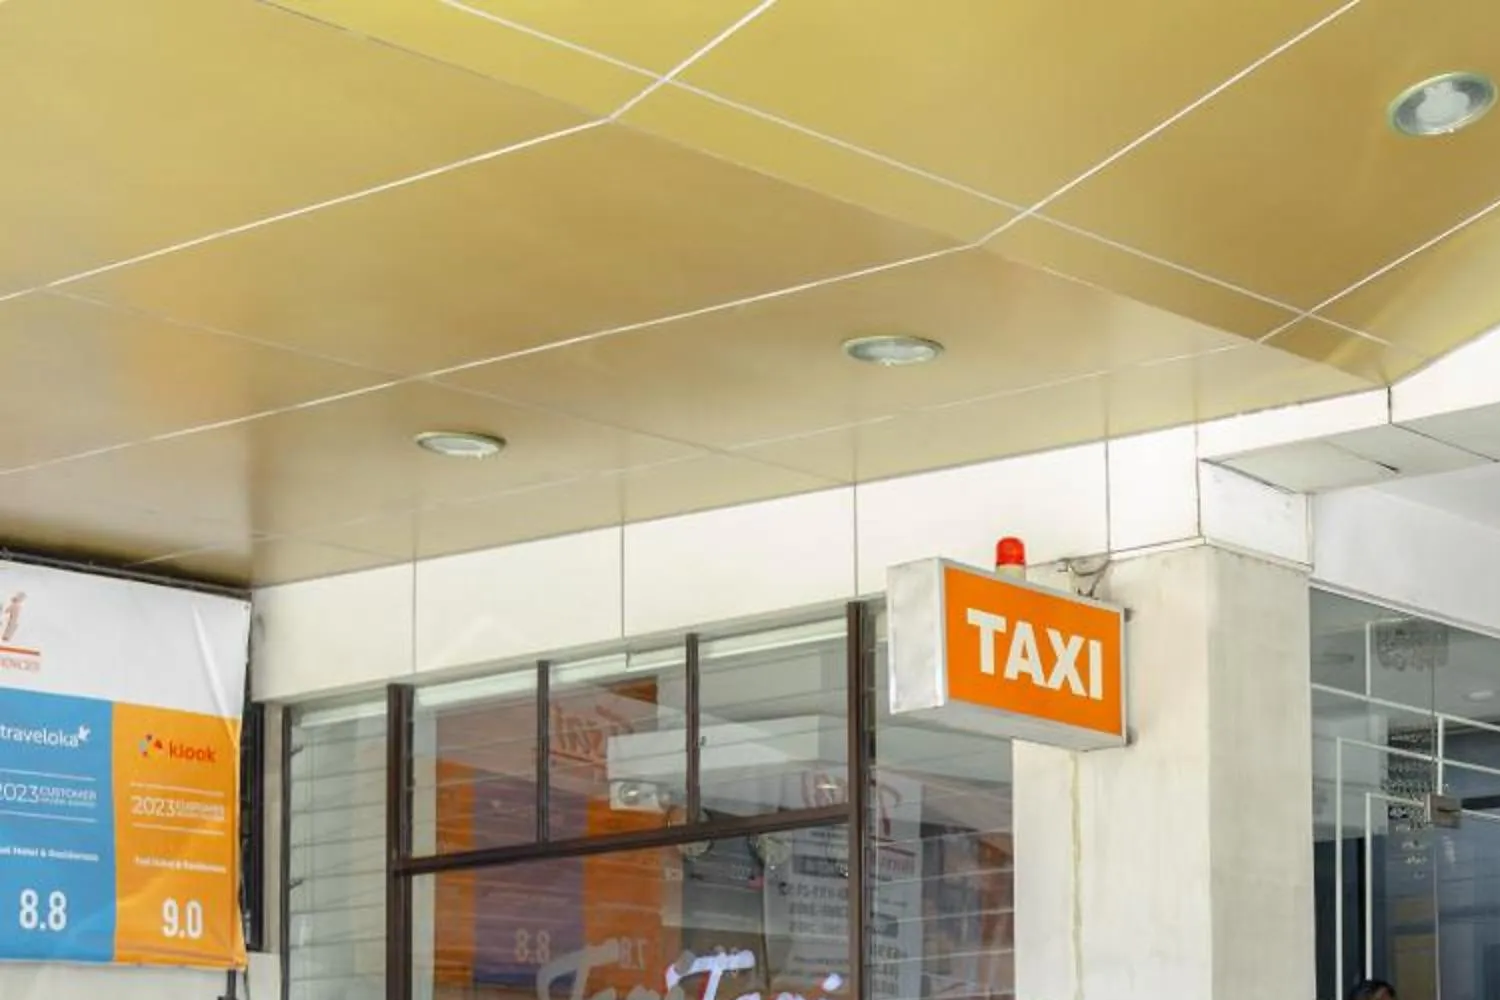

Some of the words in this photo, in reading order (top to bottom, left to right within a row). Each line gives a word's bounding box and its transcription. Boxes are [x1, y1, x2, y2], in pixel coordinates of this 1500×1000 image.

[966, 607, 1103, 701] TAXI
[0, 724, 80, 748] traveloka
[168, 741, 216, 763] klook
[0, 782, 39, 803] 023
[130, 795, 175, 817] 2023
[20, 888, 67, 930] 8.8
[162, 899, 203, 939] 9.0
